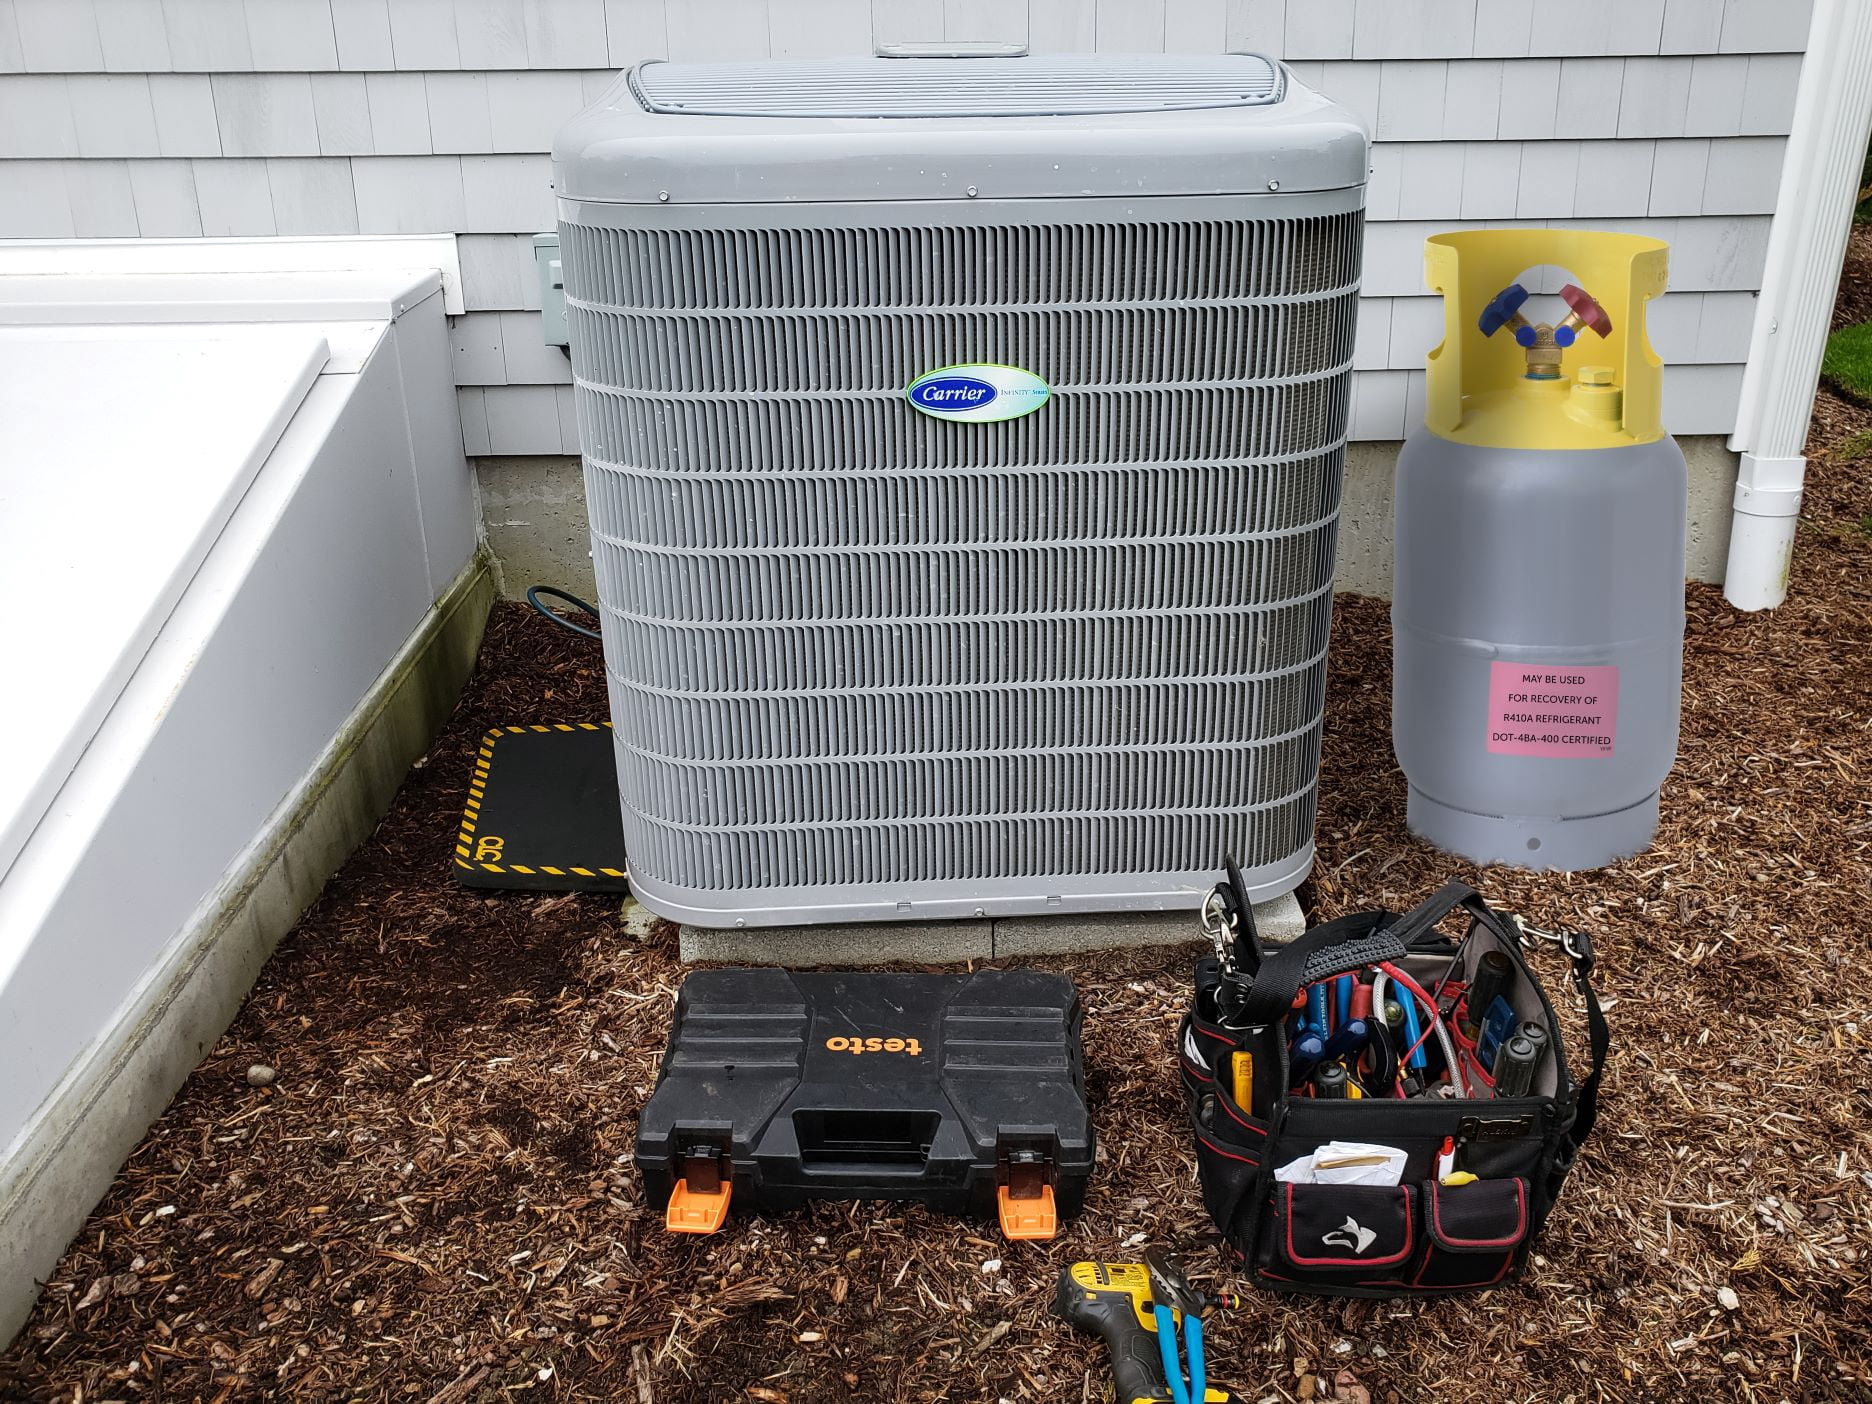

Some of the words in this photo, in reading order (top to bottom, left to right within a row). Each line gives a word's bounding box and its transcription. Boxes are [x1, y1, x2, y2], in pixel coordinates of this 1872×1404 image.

[922, 385, 986, 401] Carrier
[1522, 674, 1542, 683] MAY
[1545, 675, 1557, 684] BE
[1560, 675, 1585, 685] USED
[1508, 693, 1528, 702] FOR
[1530, 694, 1582, 704] RECOVERY
[1584, 696, 1598, 705] OF
[1503, 713, 1533, 723] R410A
[1535, 714, 1602, 725] REFRIGERANT
[1492, 732, 1559, 744] DOT-4BA-400
[1561, 735, 1611, 745] CERTIFIED
[826, 1036, 922, 1056] testo
